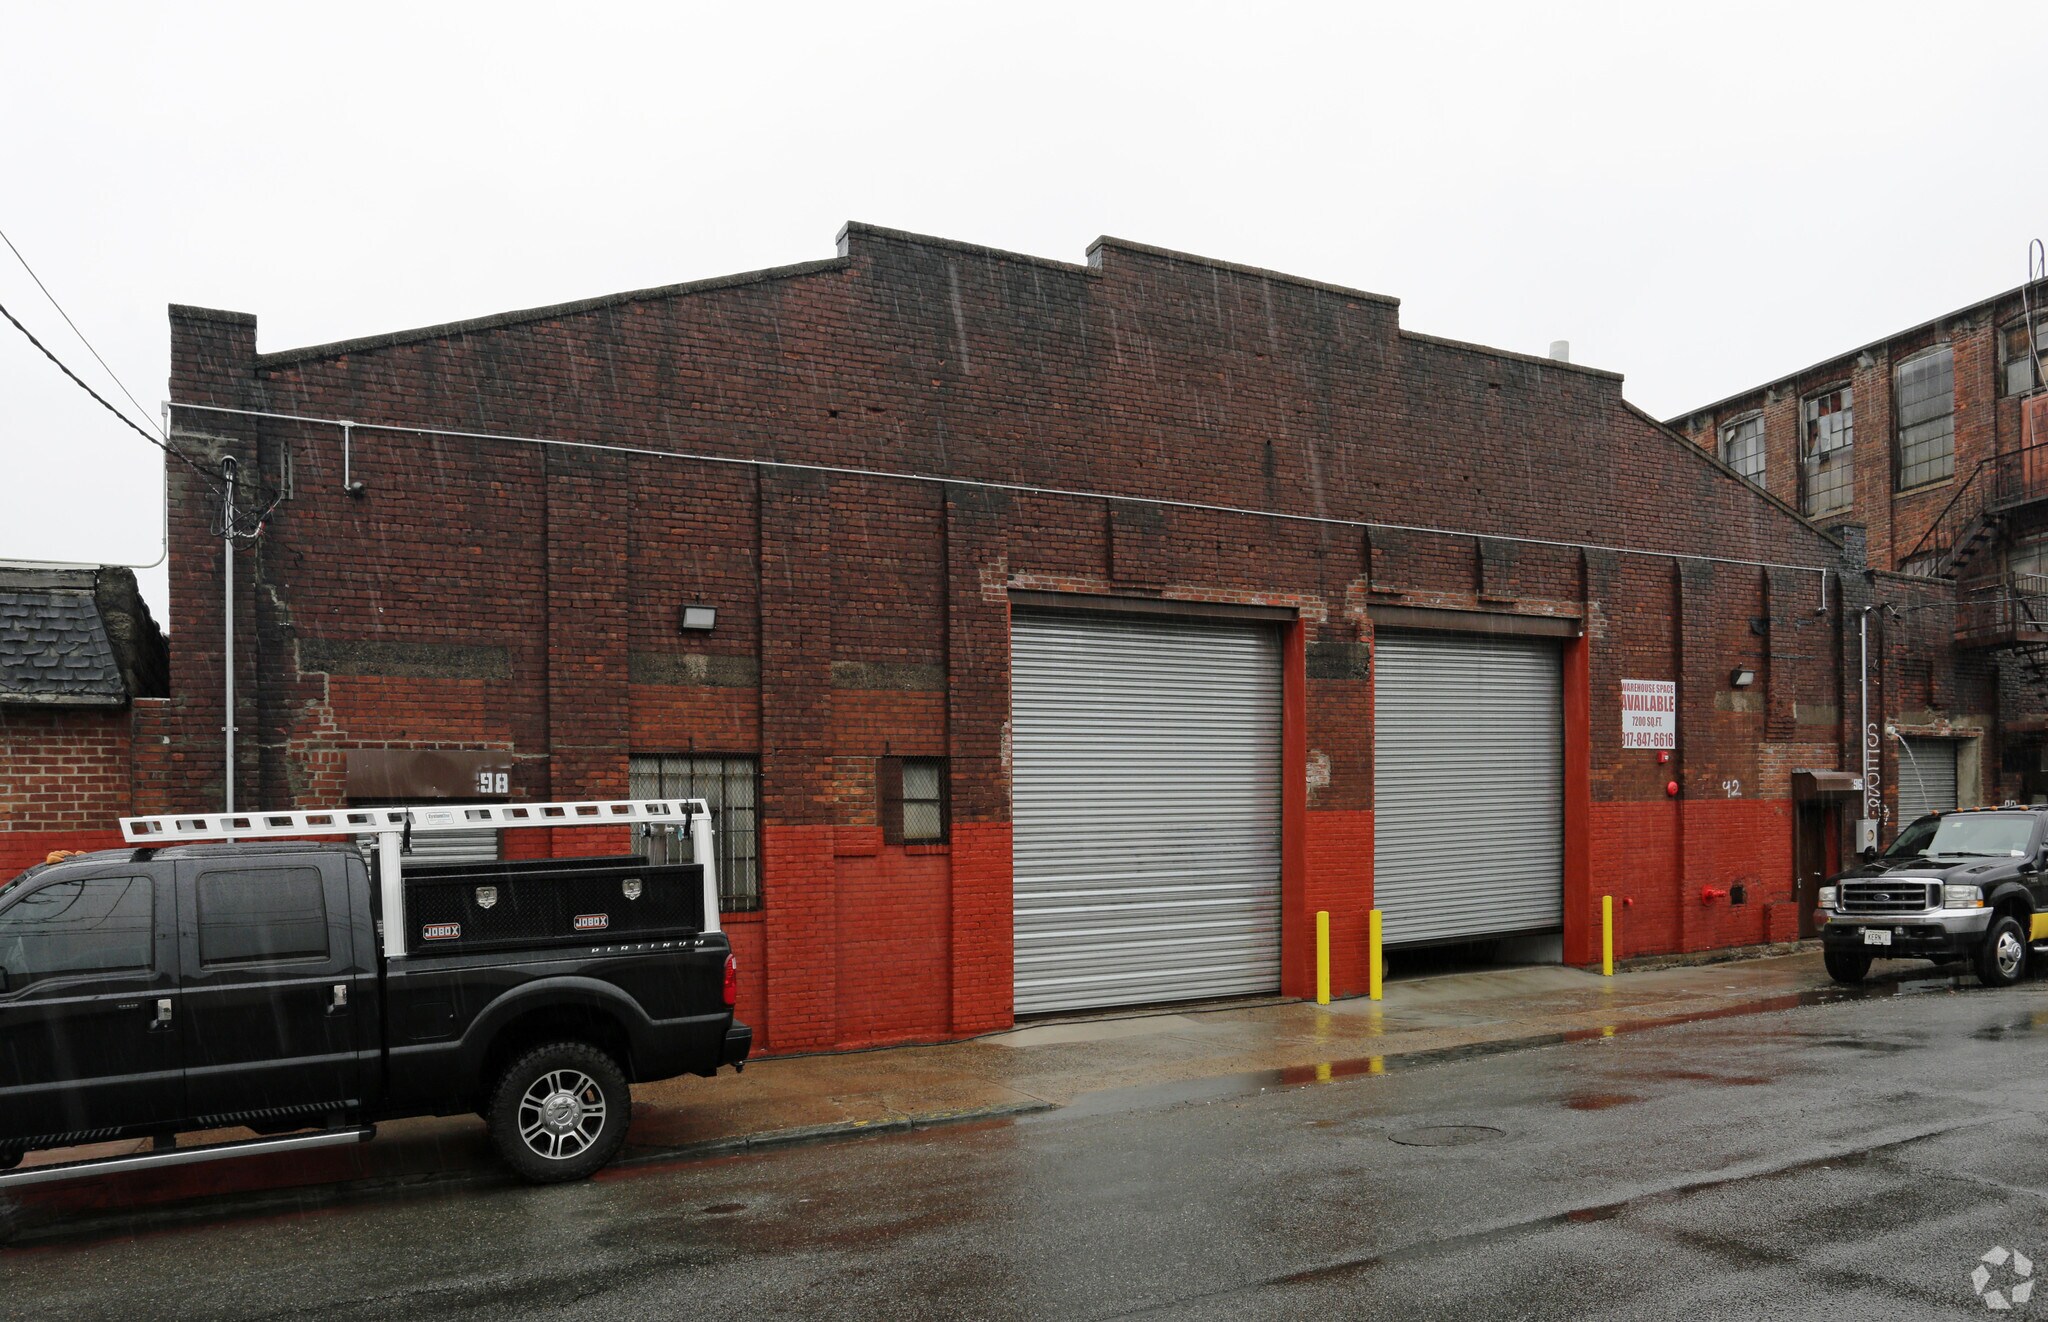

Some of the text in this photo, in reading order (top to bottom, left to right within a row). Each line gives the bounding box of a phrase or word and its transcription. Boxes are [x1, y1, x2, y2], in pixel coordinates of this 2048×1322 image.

[1622, 683, 1673, 694] WAREHOUSE SPACE
[1622, 694, 1674, 712] AVAILABLE
[1632, 716, 1646, 726] 7200
[480, 772, 508, 793] 98
[576, 916, 606, 927] JOBOX
[425, 926, 458, 936] JOBOX
[591, 940, 704, 953] PLATINUM
